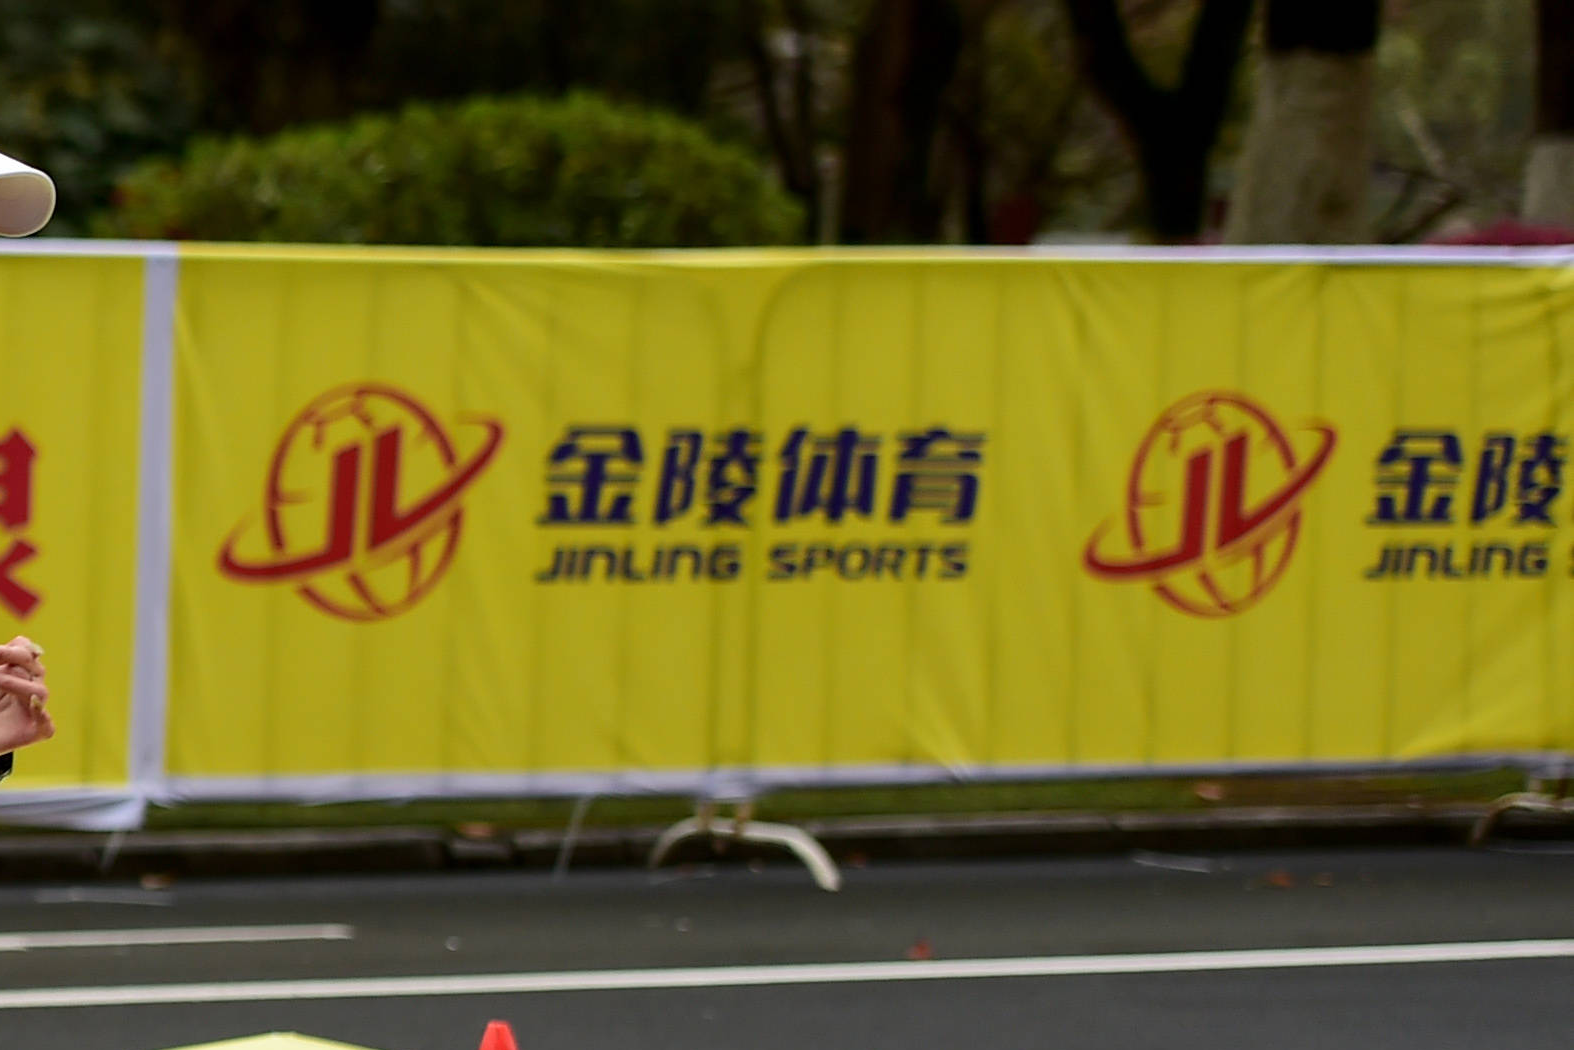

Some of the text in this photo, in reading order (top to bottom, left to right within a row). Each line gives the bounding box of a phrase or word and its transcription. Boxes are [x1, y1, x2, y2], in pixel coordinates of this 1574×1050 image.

[536, 426, 986, 528] 金陵体育
[1366, 428, 1574, 528] 金陵
[536, 542, 969, 583] JINLING SPORTS
[1364, 541, 1550, 581] JINLING
